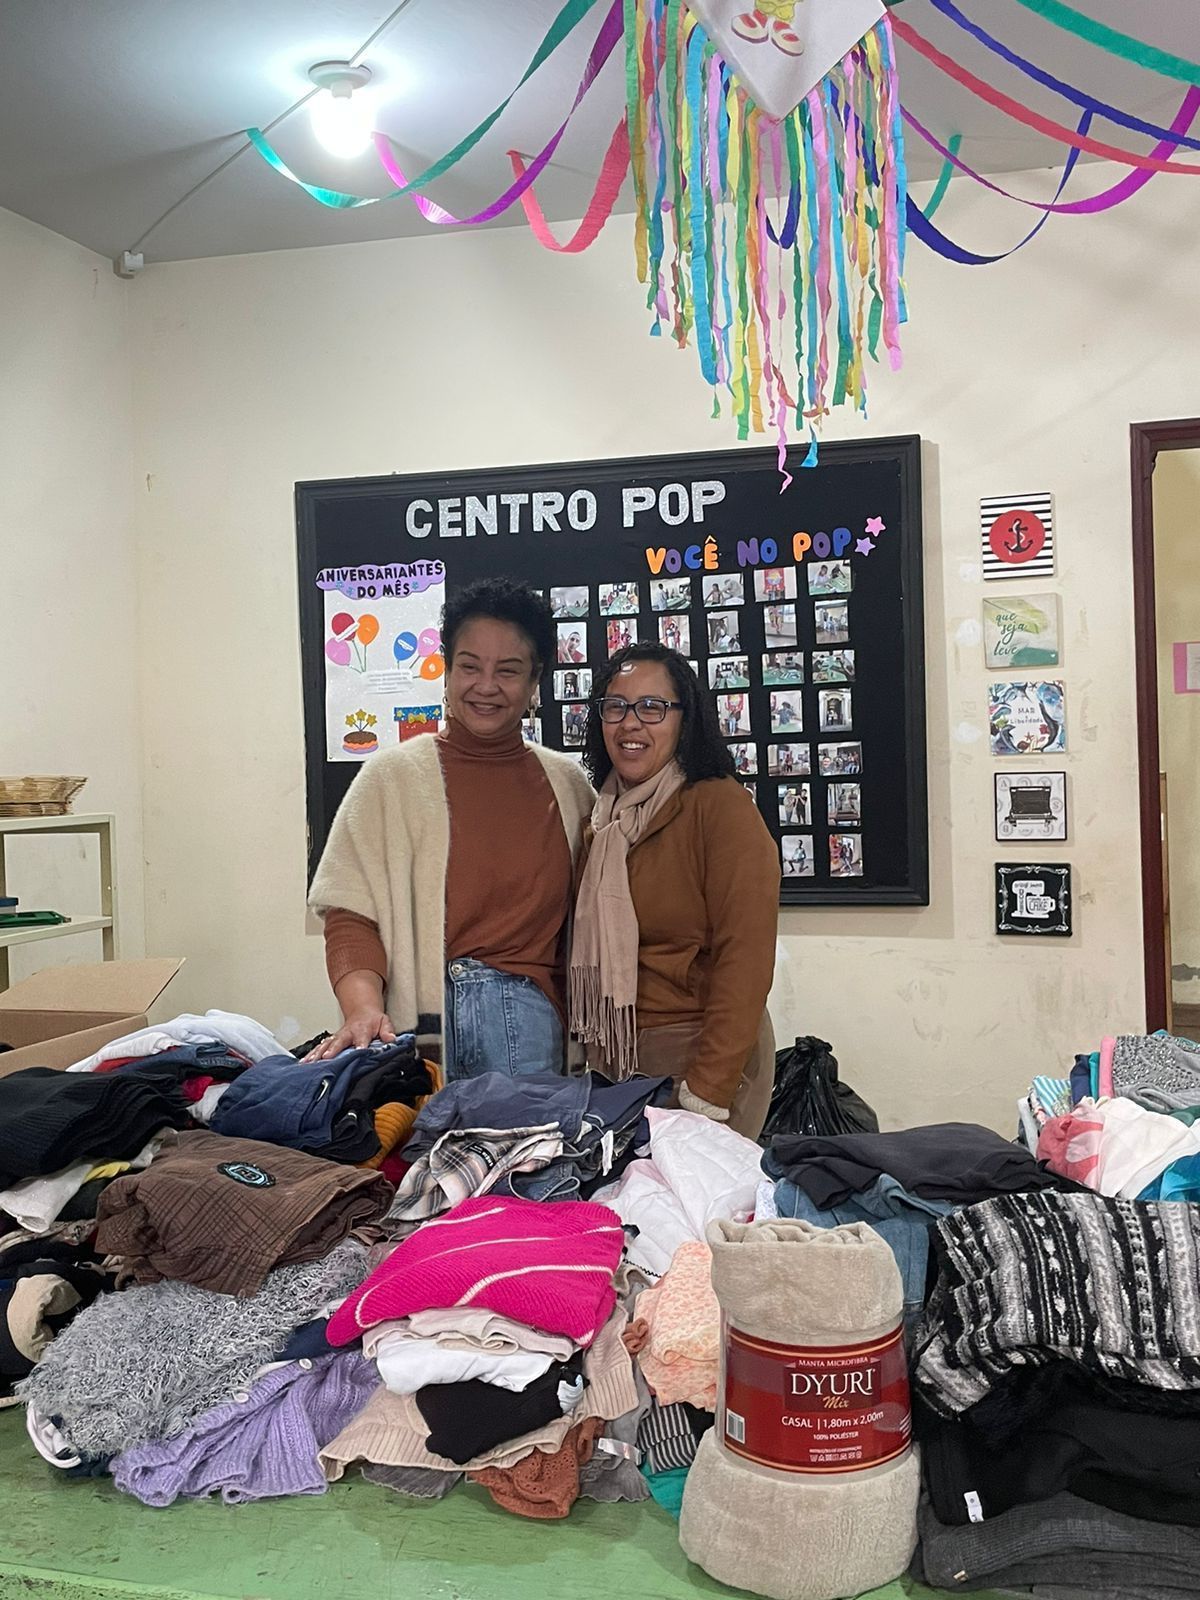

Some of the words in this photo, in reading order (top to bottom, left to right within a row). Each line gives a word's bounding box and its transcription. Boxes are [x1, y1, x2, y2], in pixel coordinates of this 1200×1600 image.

[405, 489, 597, 539] CENTRO
[622, 480, 726, 528] POP
[646, 535, 719, 575] VOCÊ
[737, 537, 778, 567] NO
[792, 527, 852, 562] POP
[318, 562, 443, 582] ANIVERSARIANTES
[357, 585, 377, 598] DO
[382, 580, 410, 596] MÊS
[995, 613, 1017, 627] que
[1001, 621, 1027, 645] seja
[994, 640, 1018, 656] leve
[799, 1359, 825, 1367] MANTA
[827, 1356, 869, 1367] MICROFIBRA
[791, 1368, 873, 1396] DYURI
[823, 1396, 849, 1409] Mix
[781, 1416, 813, 1428] CASAL
[823, 1418, 851, 1429] 1,80m
[860, 1411, 884, 1425] 2,00m
[829, 1431, 859, 1440] POLIÉSTER
